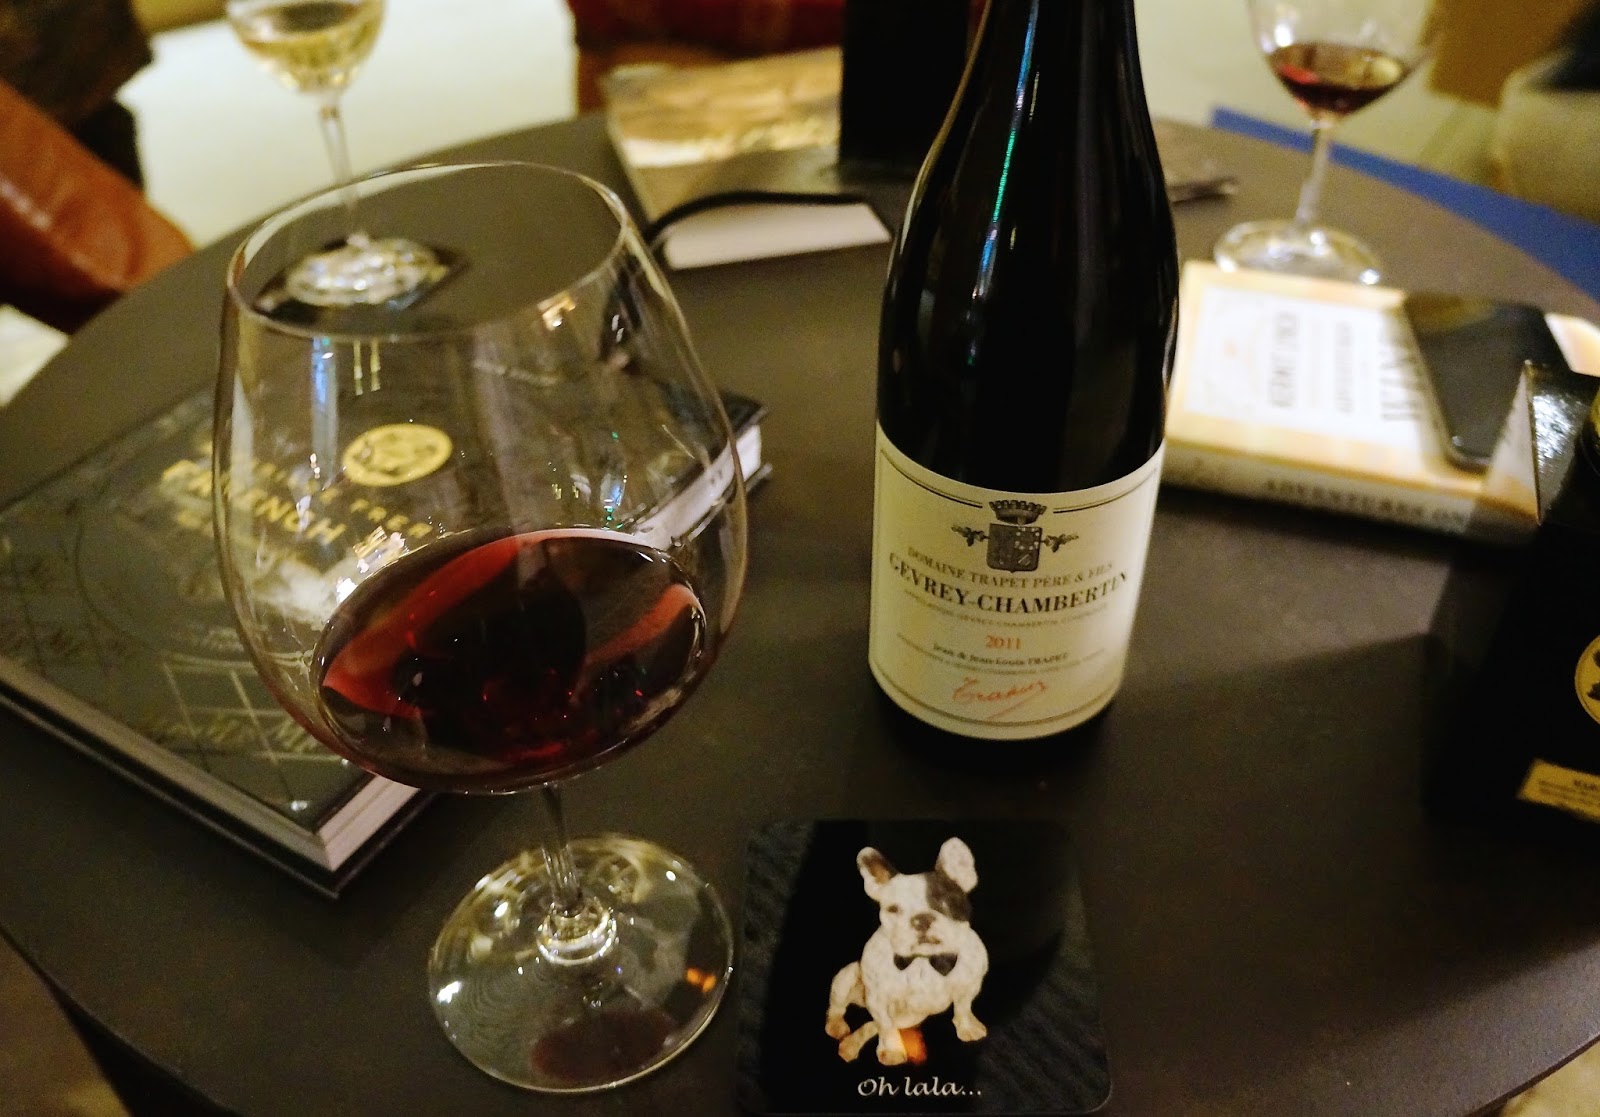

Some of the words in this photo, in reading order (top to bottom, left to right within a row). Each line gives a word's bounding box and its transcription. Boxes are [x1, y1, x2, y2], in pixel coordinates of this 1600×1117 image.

[888, 551, 1128, 614] GEVREY-CHAMBERTIN
[907, 546, 966, 580] DOMAINE
[969, 571, 1027, 589] TRAPET
[985, 633, 1022, 651] 2011
[857, 1075, 901, 1097] Oh
[903, 1075, 983, 1097] lala...
